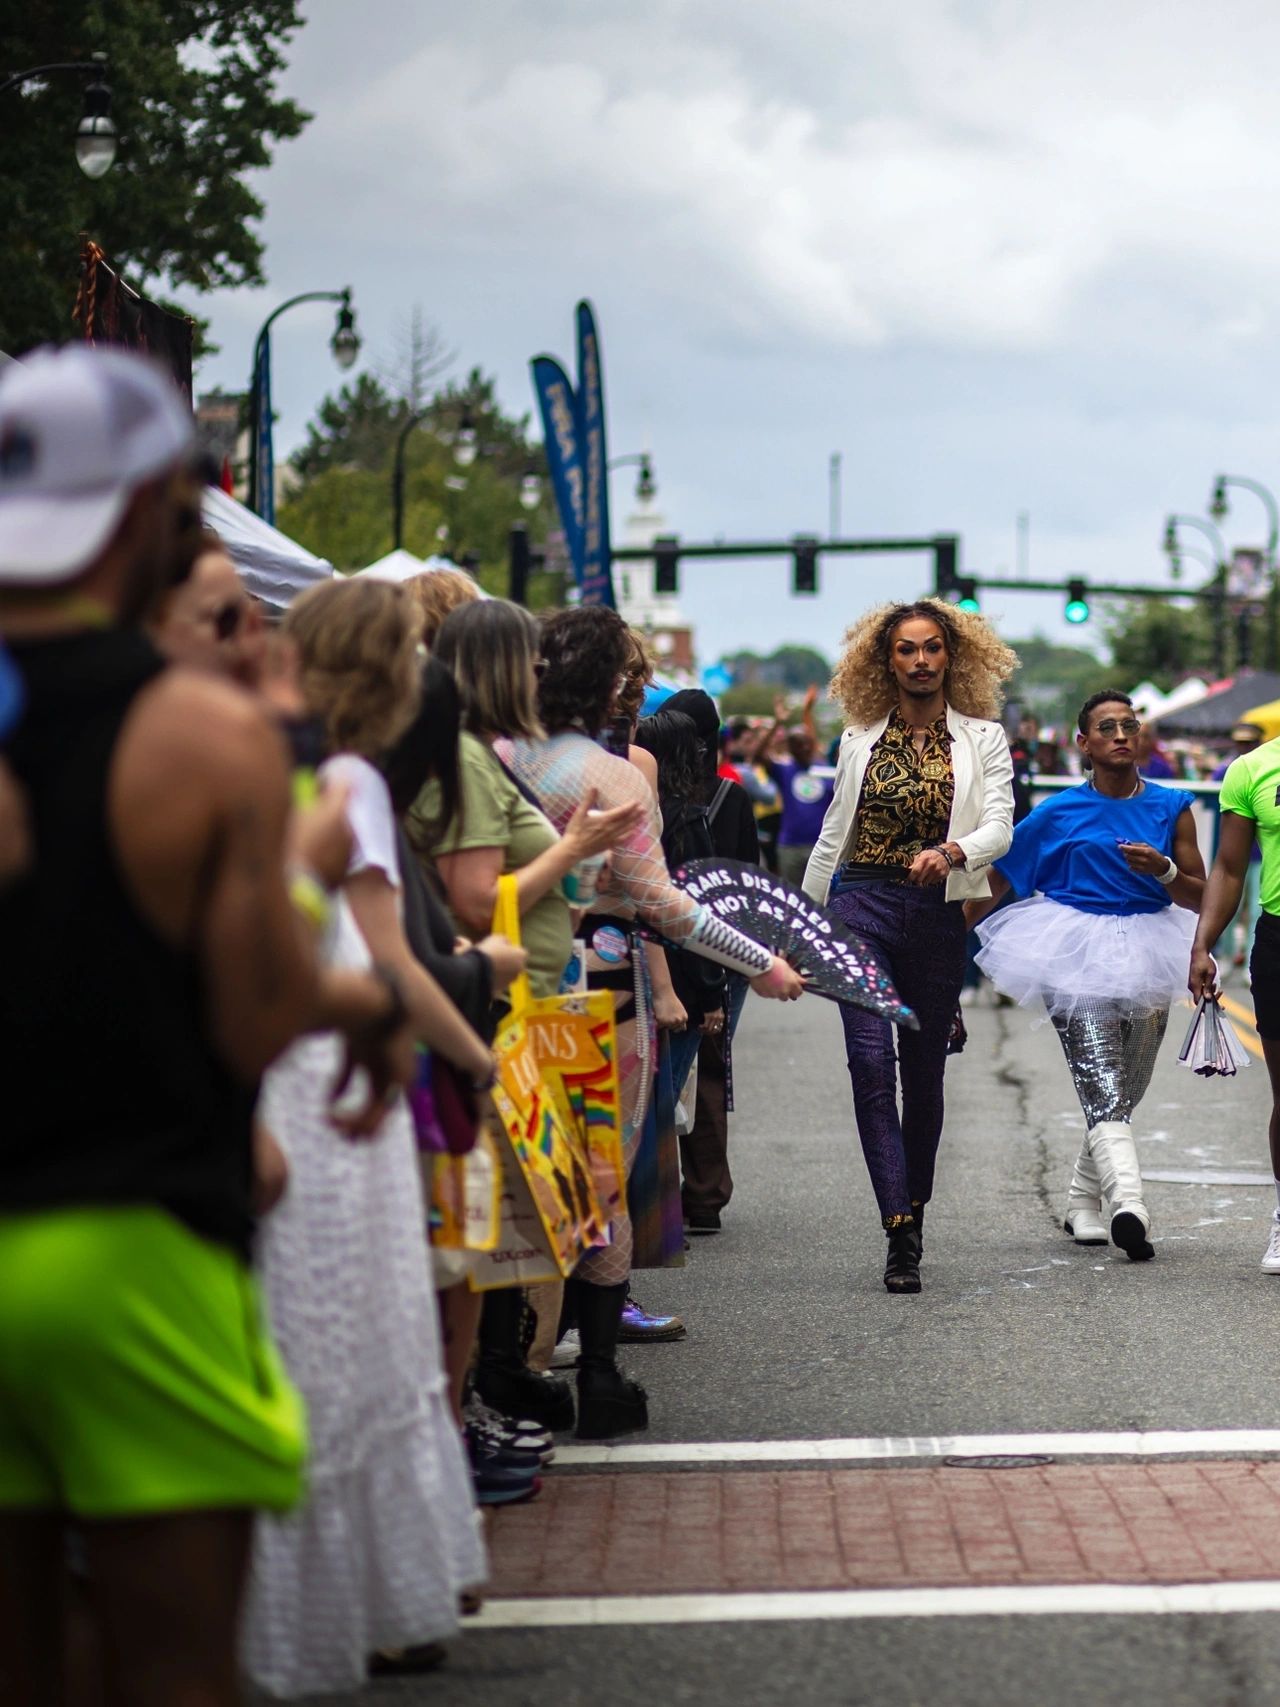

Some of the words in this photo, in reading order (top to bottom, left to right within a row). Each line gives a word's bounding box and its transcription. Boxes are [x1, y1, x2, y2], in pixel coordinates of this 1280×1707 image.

[684, 869, 738, 898] RANS,
[741, 871, 832, 934] DISABLED
[832, 940, 863, 977] AND
[757, 900, 785, 922] AS
[791, 918, 836, 961] FUCK
